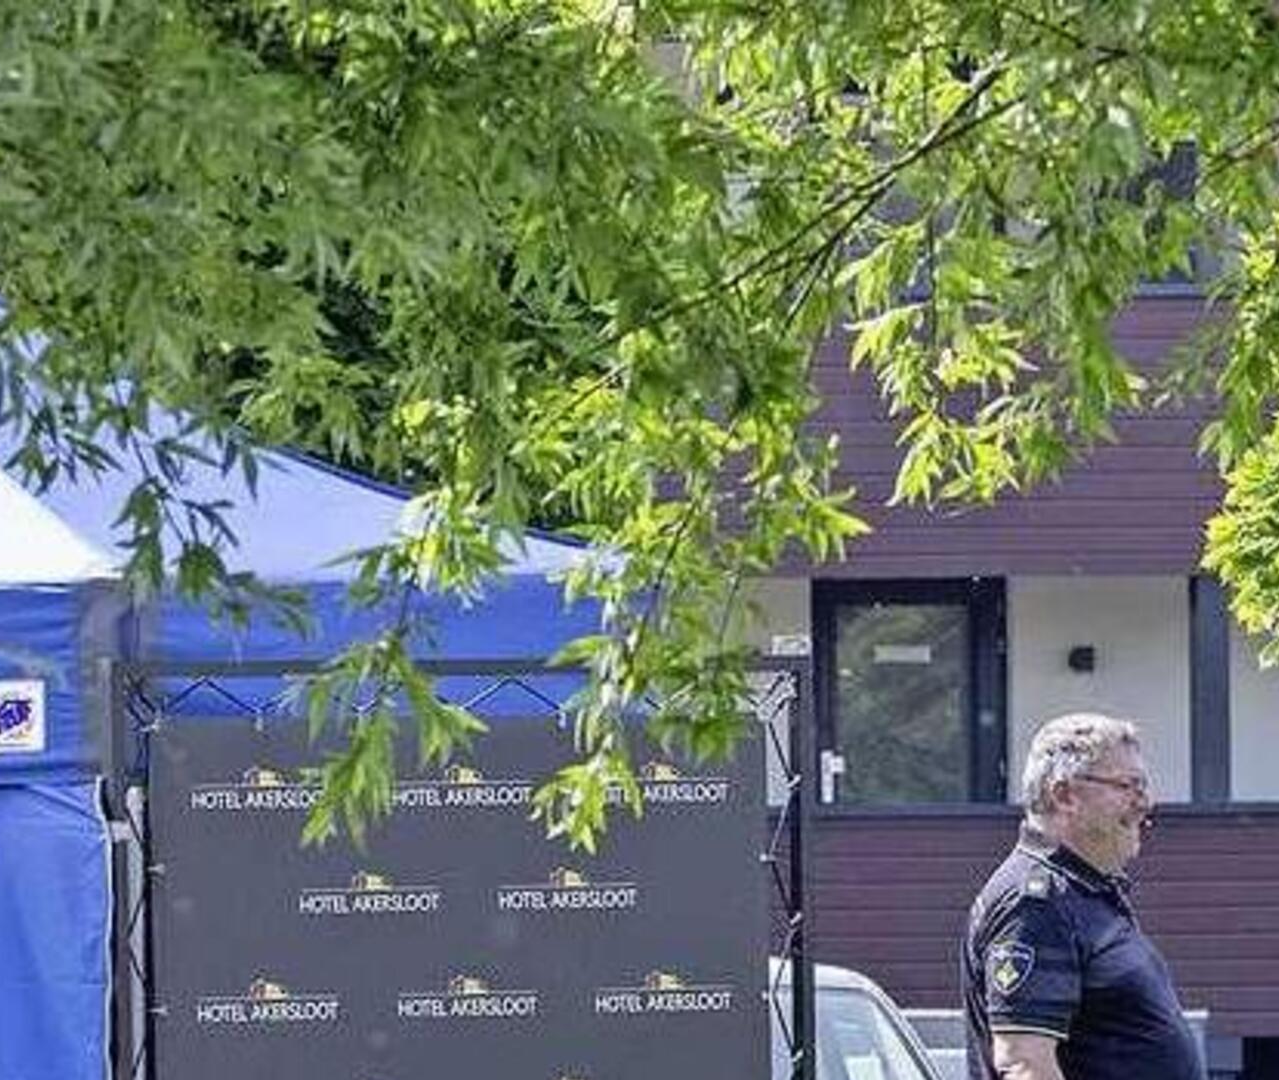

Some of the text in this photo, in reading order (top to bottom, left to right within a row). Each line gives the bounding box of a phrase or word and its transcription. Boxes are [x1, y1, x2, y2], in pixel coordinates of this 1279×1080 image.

[191, 791, 242, 809] HOTEL
[445, 785, 533, 806] AKERSLOOT
[643, 781, 729, 803] AKERSLOOT
[299, 891, 439, 914] HOTEL AKERSLOOT
[499, 888, 637, 909] HOTEL AKERSLOOT
[198, 1001, 338, 1023] HOTEL AKERSLOOT
[398, 996, 538, 1017] HOTEL AKERSLOOT
[596, 992, 731, 1013] HOTEL AKERSLOOT
